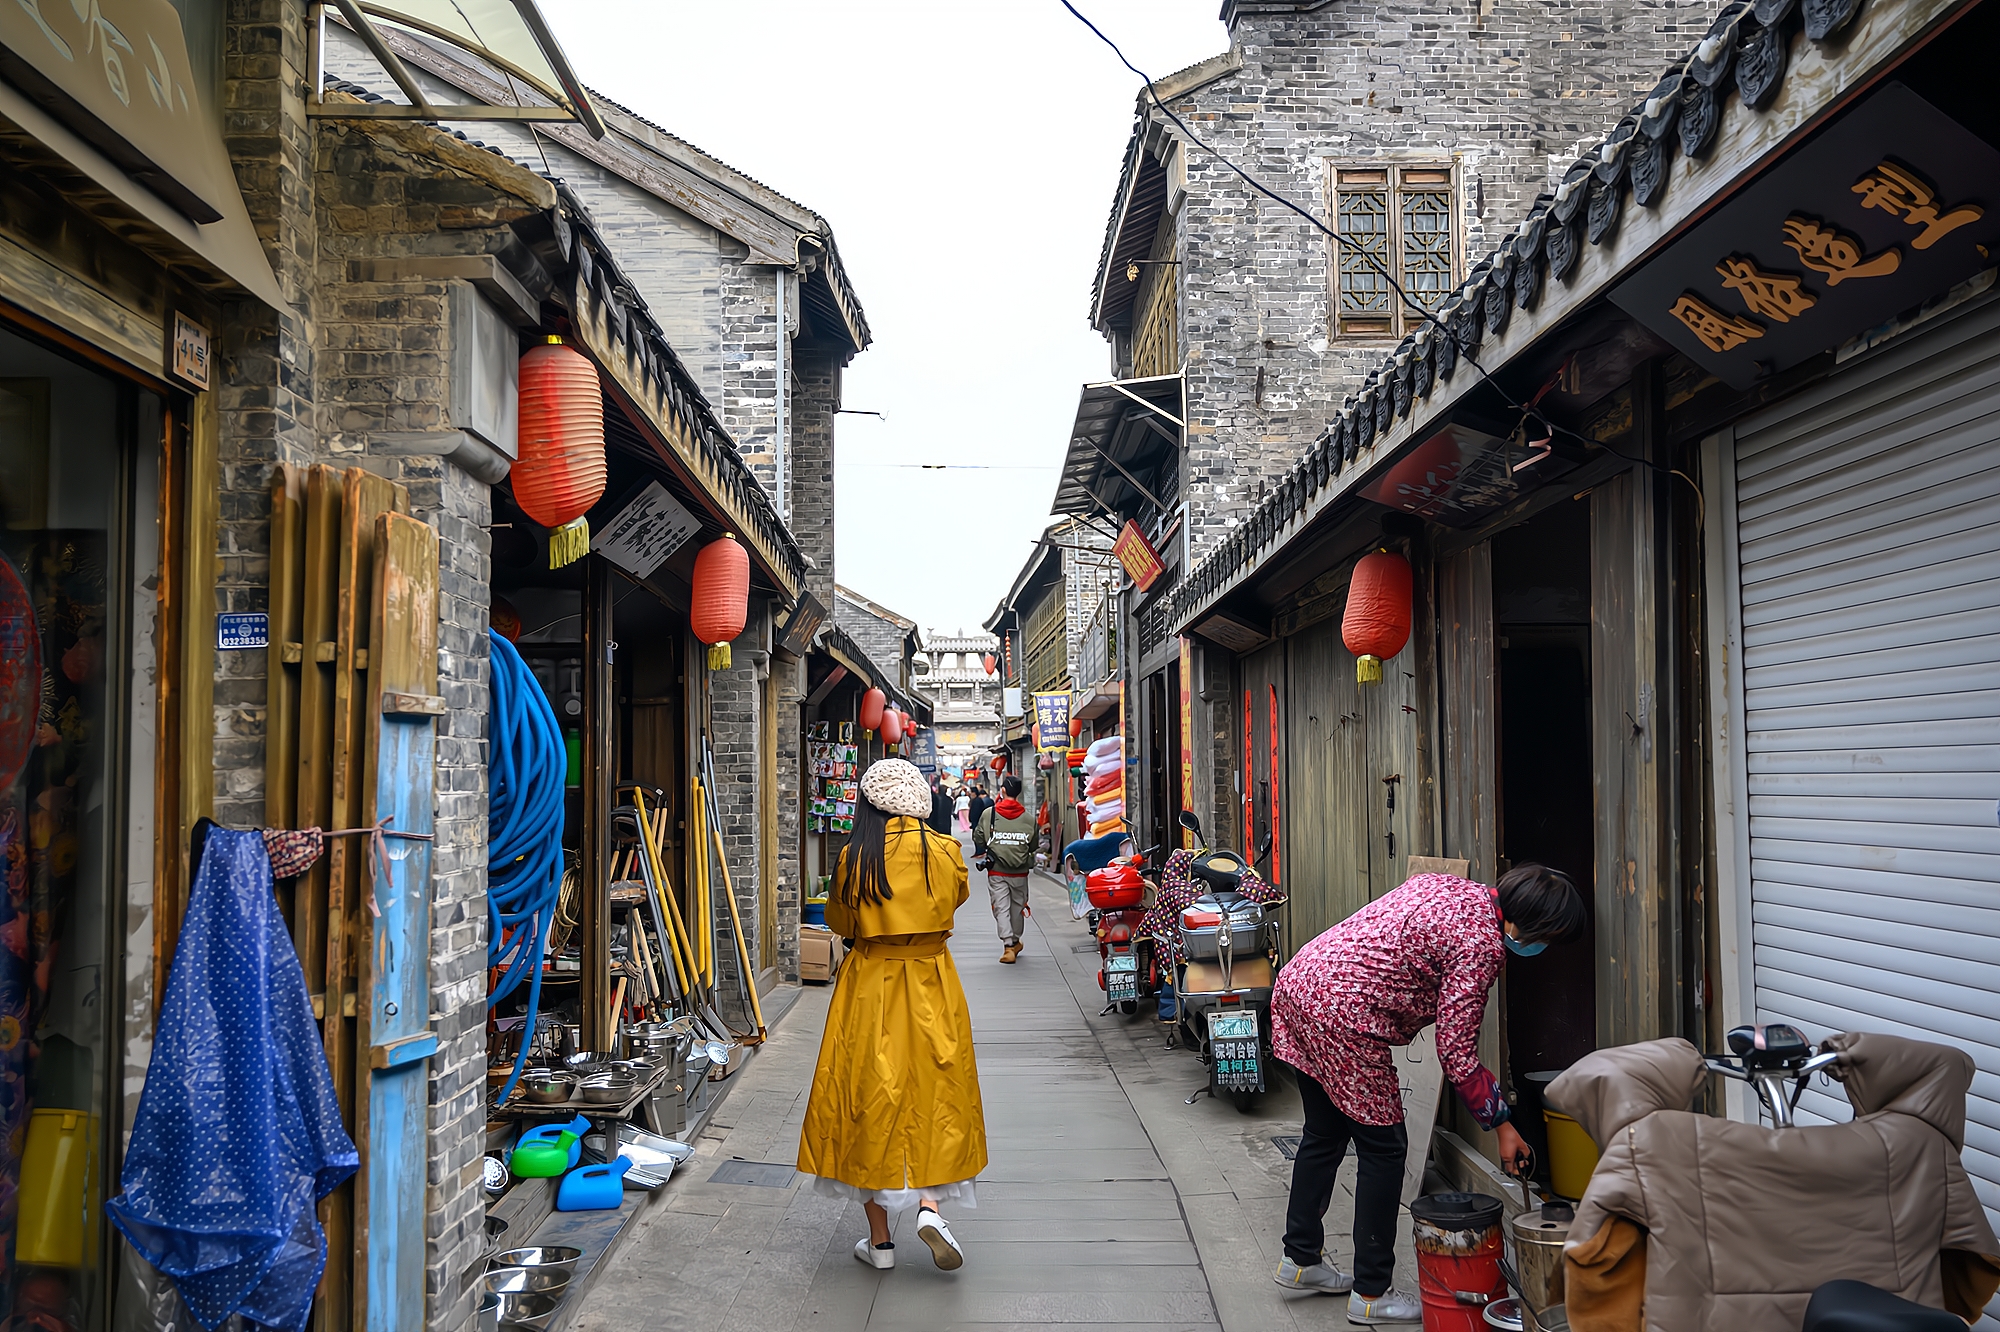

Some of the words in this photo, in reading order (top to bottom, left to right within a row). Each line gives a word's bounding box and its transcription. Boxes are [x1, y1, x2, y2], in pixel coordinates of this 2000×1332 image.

[1668, 160, 1985, 353] 風格造型
[180, 338, 205, 368] 41号
[1038, 707, 1068, 725] 寿衣
[1215, 1042, 1257, 1059] 深圳台铃
[1217, 1059, 1258, 1073] 澳柯玛
